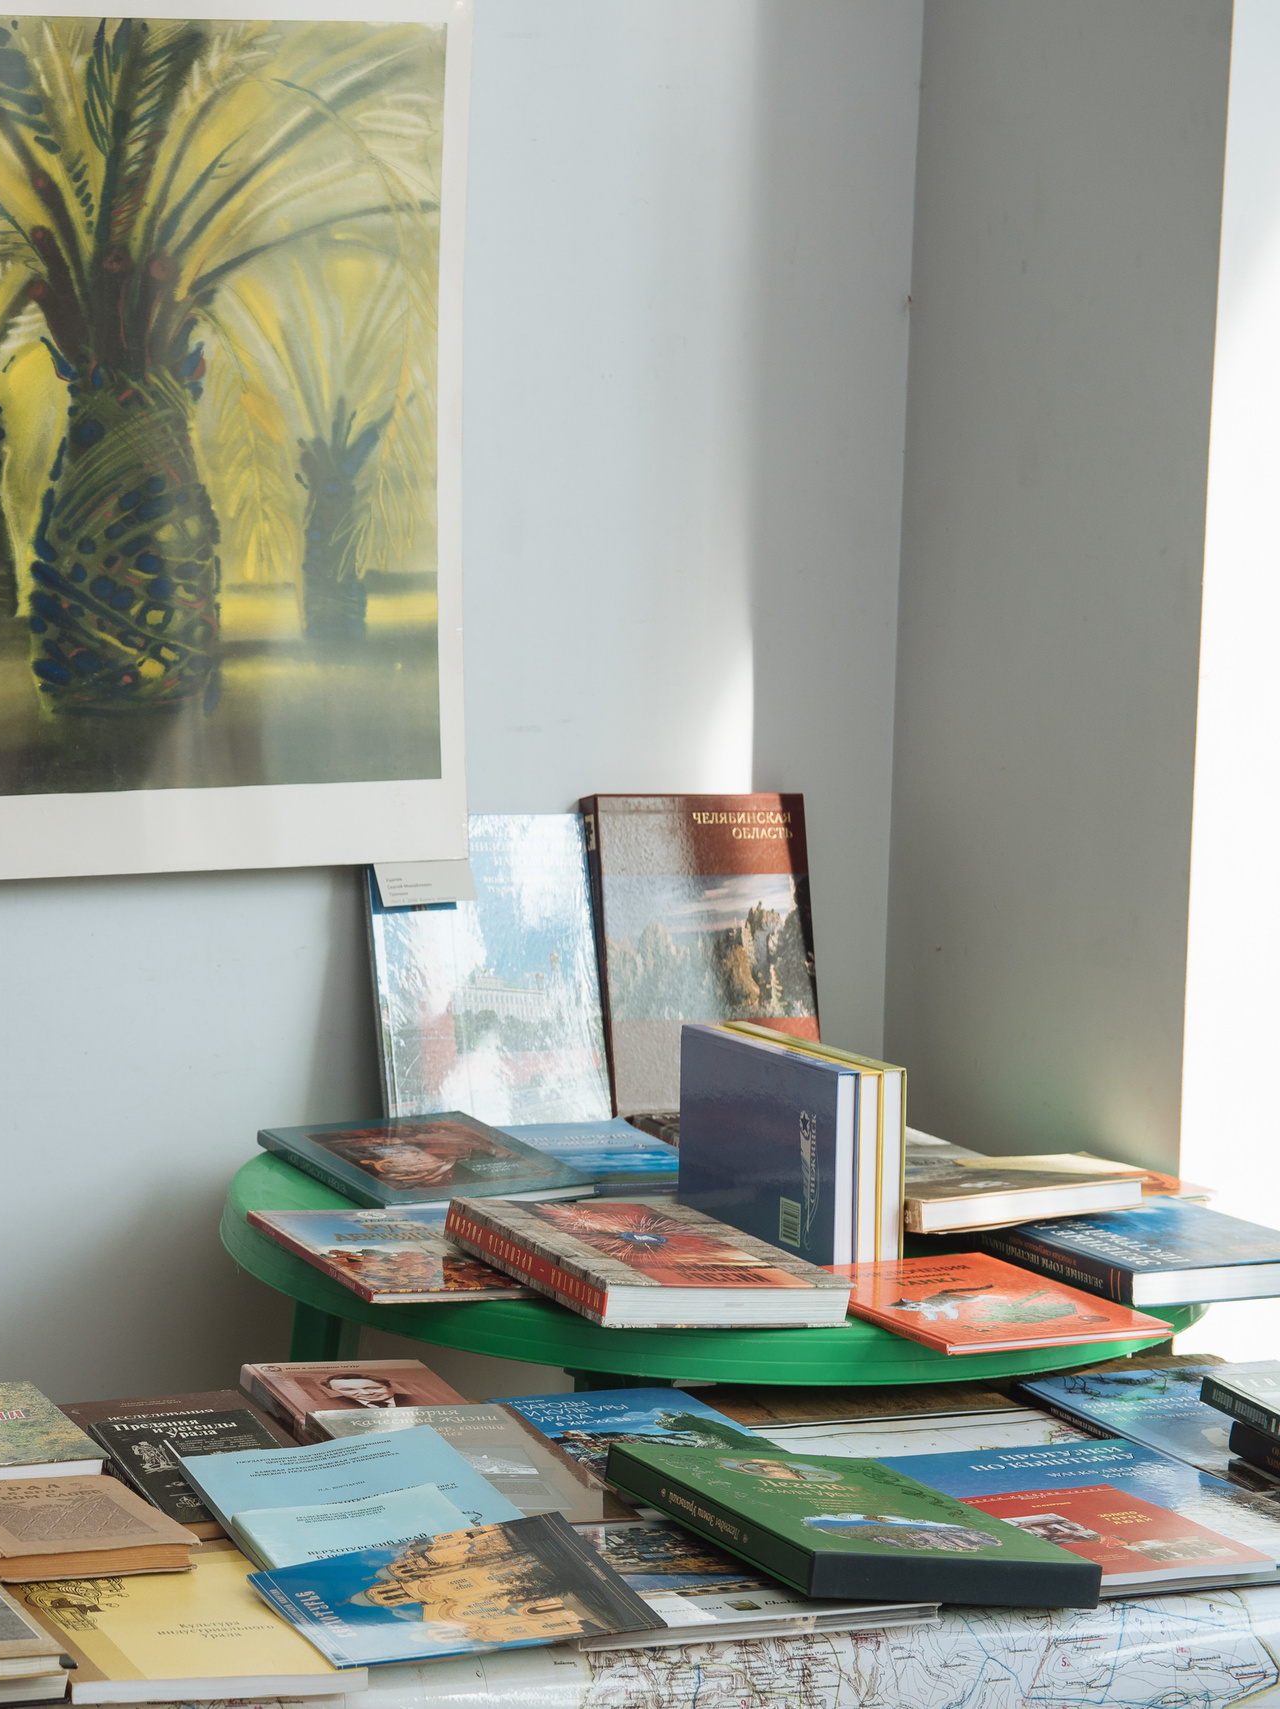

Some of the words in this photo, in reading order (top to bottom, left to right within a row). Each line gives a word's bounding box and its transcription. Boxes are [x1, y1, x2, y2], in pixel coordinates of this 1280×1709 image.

[692, 811, 791, 824] ЧЕЛЯБИНСКАЯ
[732, 827, 793, 839] ОБЛАСТЬ
[449, 1213, 482, 1244] РОССИИ
[488, 1234, 533, 1271] КРЕПОСТЬ
[1041, 1258, 1065, 1276] ГОРЫ
[1066, 1269, 1104, 1290] ЗЕЛЕНЫЕ
[551, 1268, 600, 1308] МАГНИТКА
[514, 1400, 590, 1411] НАРОДЫ
[543, 1403, 629, 1415] КУЛЬТУРЫ
[107, 1408, 215, 1421] ИССЛЕДОВАНИЯ
[373, 1409, 459, 1419] История
[533, 1413, 594, 1422] УРАЛА
[112, 1419, 200, 1432] Предания
[350, 1417, 435, 1427] качества
[440, 1415, 500, 1424] жизни
[152, 1427, 164, 1435] и
[996, 1446, 1124, 1462] ПРОГУЛКИ
[969, 1463, 1006, 1472] ПО
[1008, 1453, 1136, 1469] КЫШТЫМУ
[308, 1538, 395, 1556] ВЕРХОТУРСКИЙ
[397, 1532, 427, 1545] КРАЙ
